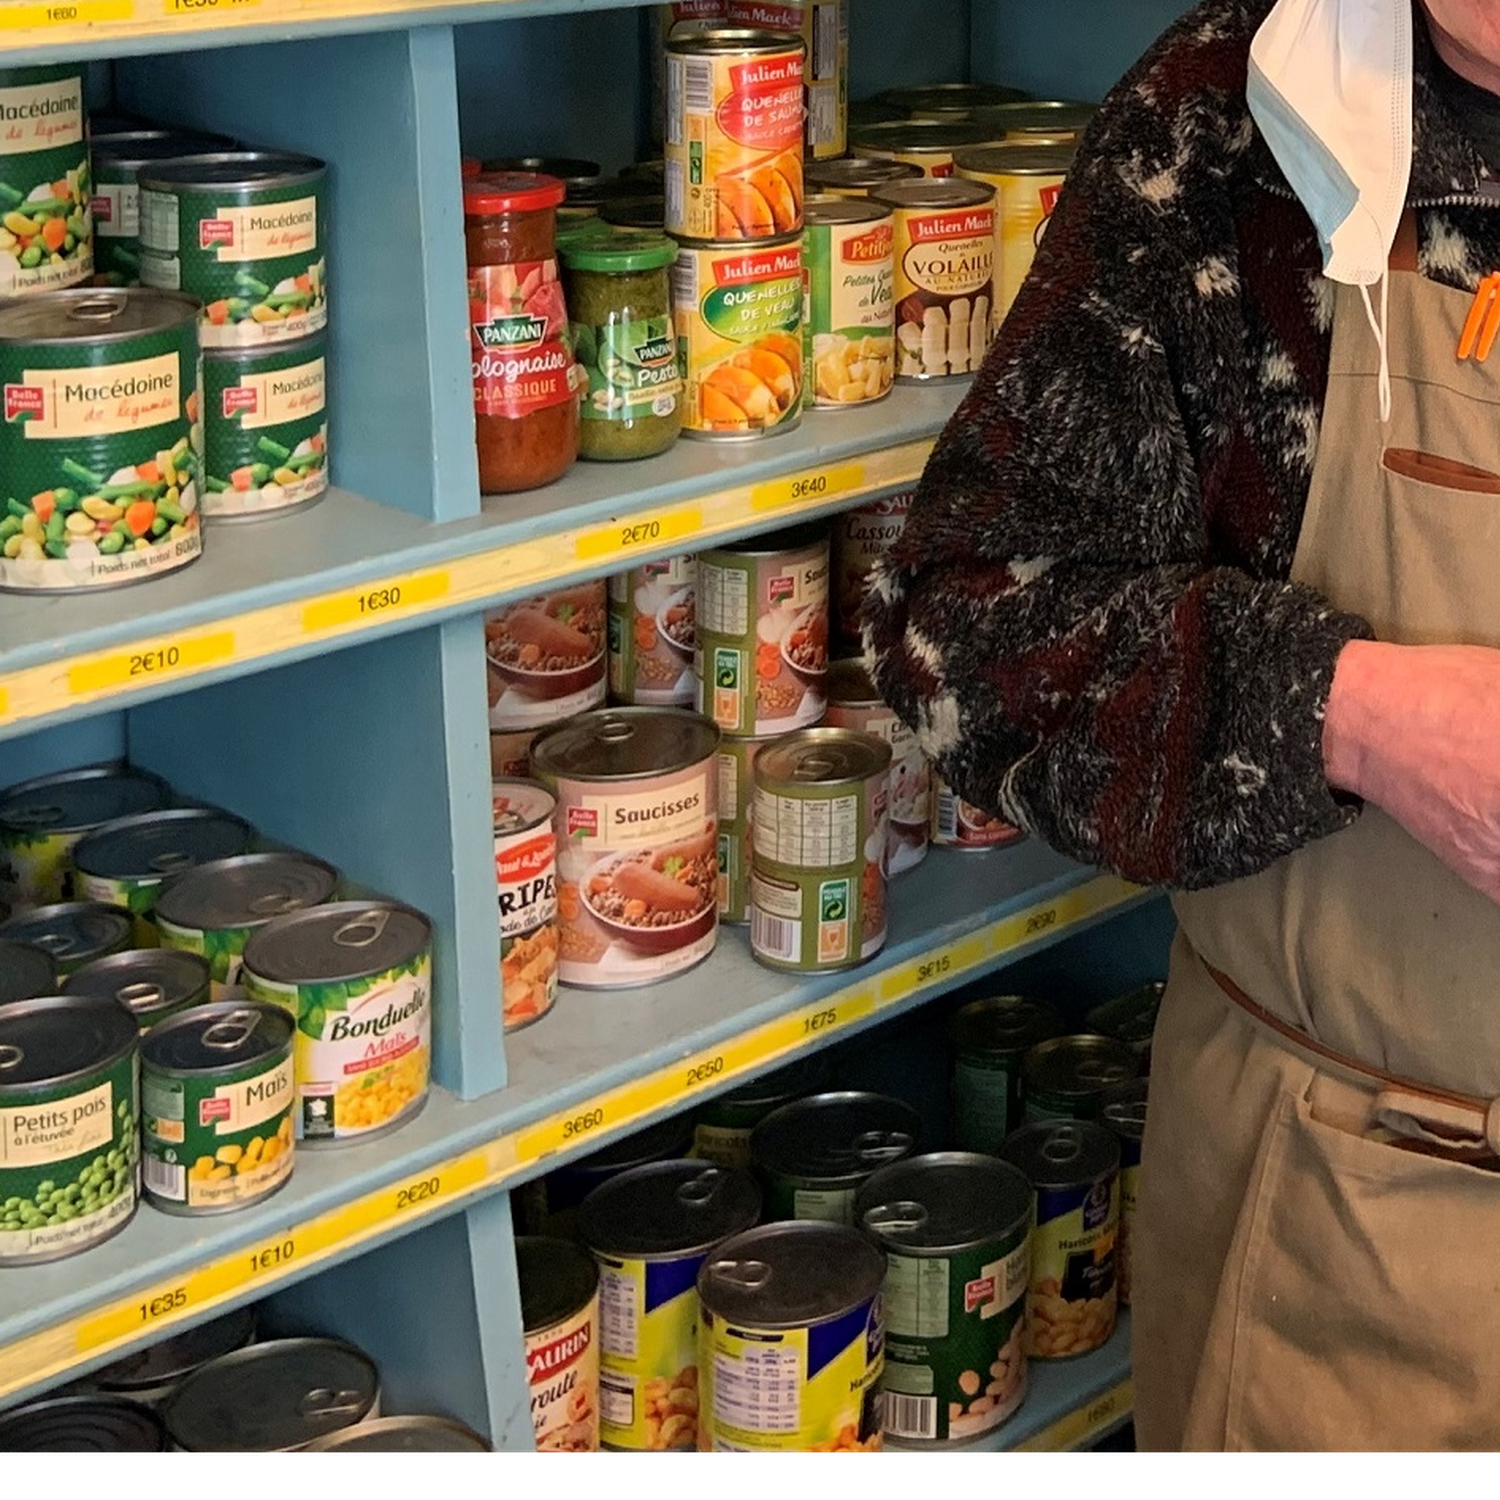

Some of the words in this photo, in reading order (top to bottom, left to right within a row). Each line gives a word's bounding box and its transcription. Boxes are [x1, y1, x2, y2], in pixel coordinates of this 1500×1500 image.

[741, 67, 785, 85] Julien
[743, 116, 763, 128] DE
[250, 211, 313, 231] Macédoine
[917, 220, 962, 238] Julien
[723, 260, 771, 279] Julien
[740, 307, 760, 321] DE
[765, 299, 795, 318] VEAU
[483, 322, 542, 342] PANZANI
[472, 350, 566, 383] olognaise
[65, 372, 173, 402] Macédoine
[474, 378, 557, 400] CLASSIQUE
[792, 477, 827, 497] 3€40
[622, 522, 660, 545] 2€70
[358, 588, 401, 612] 1€30
[129, 648, 179, 675] 2€10
[615, 792, 700, 826] Saucisses
[918, 957, 951, 982] 3€15
[331, 990, 427, 1044] Bonduelle
[804, 1009, 837, 1032] 1€75
[687, 1058, 723, 1085] 2€50
[246, 1072, 289, 1108] Maïs
[13, 1112, 69, 1135] Petits
[73, 1096, 107, 1128] pois
[563, 1109, 604, 1138] 3€60
[396, 1178, 440, 1209] 2€20
[251, 1242, 294, 1271] 1€10
[139, 1288, 186, 1320] 1€35
[530, 1326, 589, 1372] AURIN
